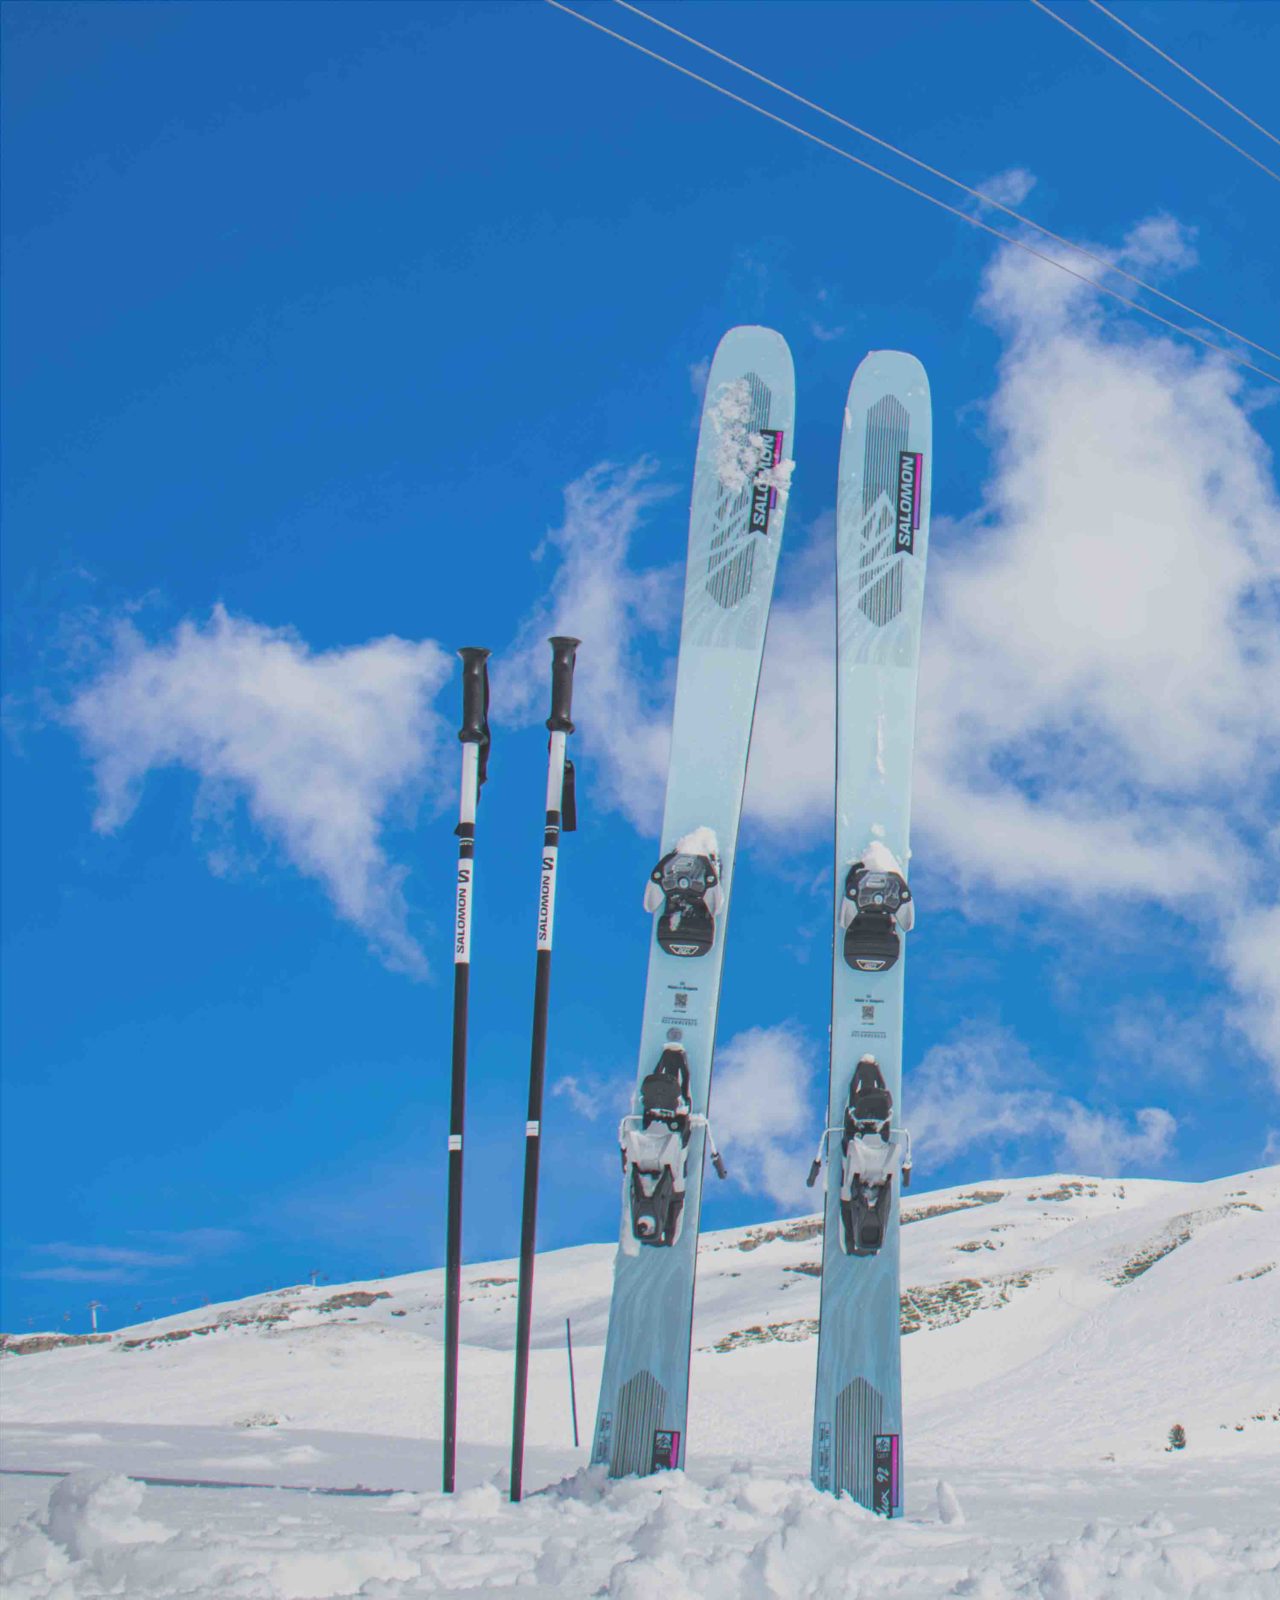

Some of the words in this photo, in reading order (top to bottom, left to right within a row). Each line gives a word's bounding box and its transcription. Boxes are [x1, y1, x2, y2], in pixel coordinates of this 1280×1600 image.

[898, 456, 914, 546] SALOMON
[457, 888, 467, 954] SALOMON
[539, 875, 550, 941] SALOMON
[876, 1466, 889, 1483] 92
